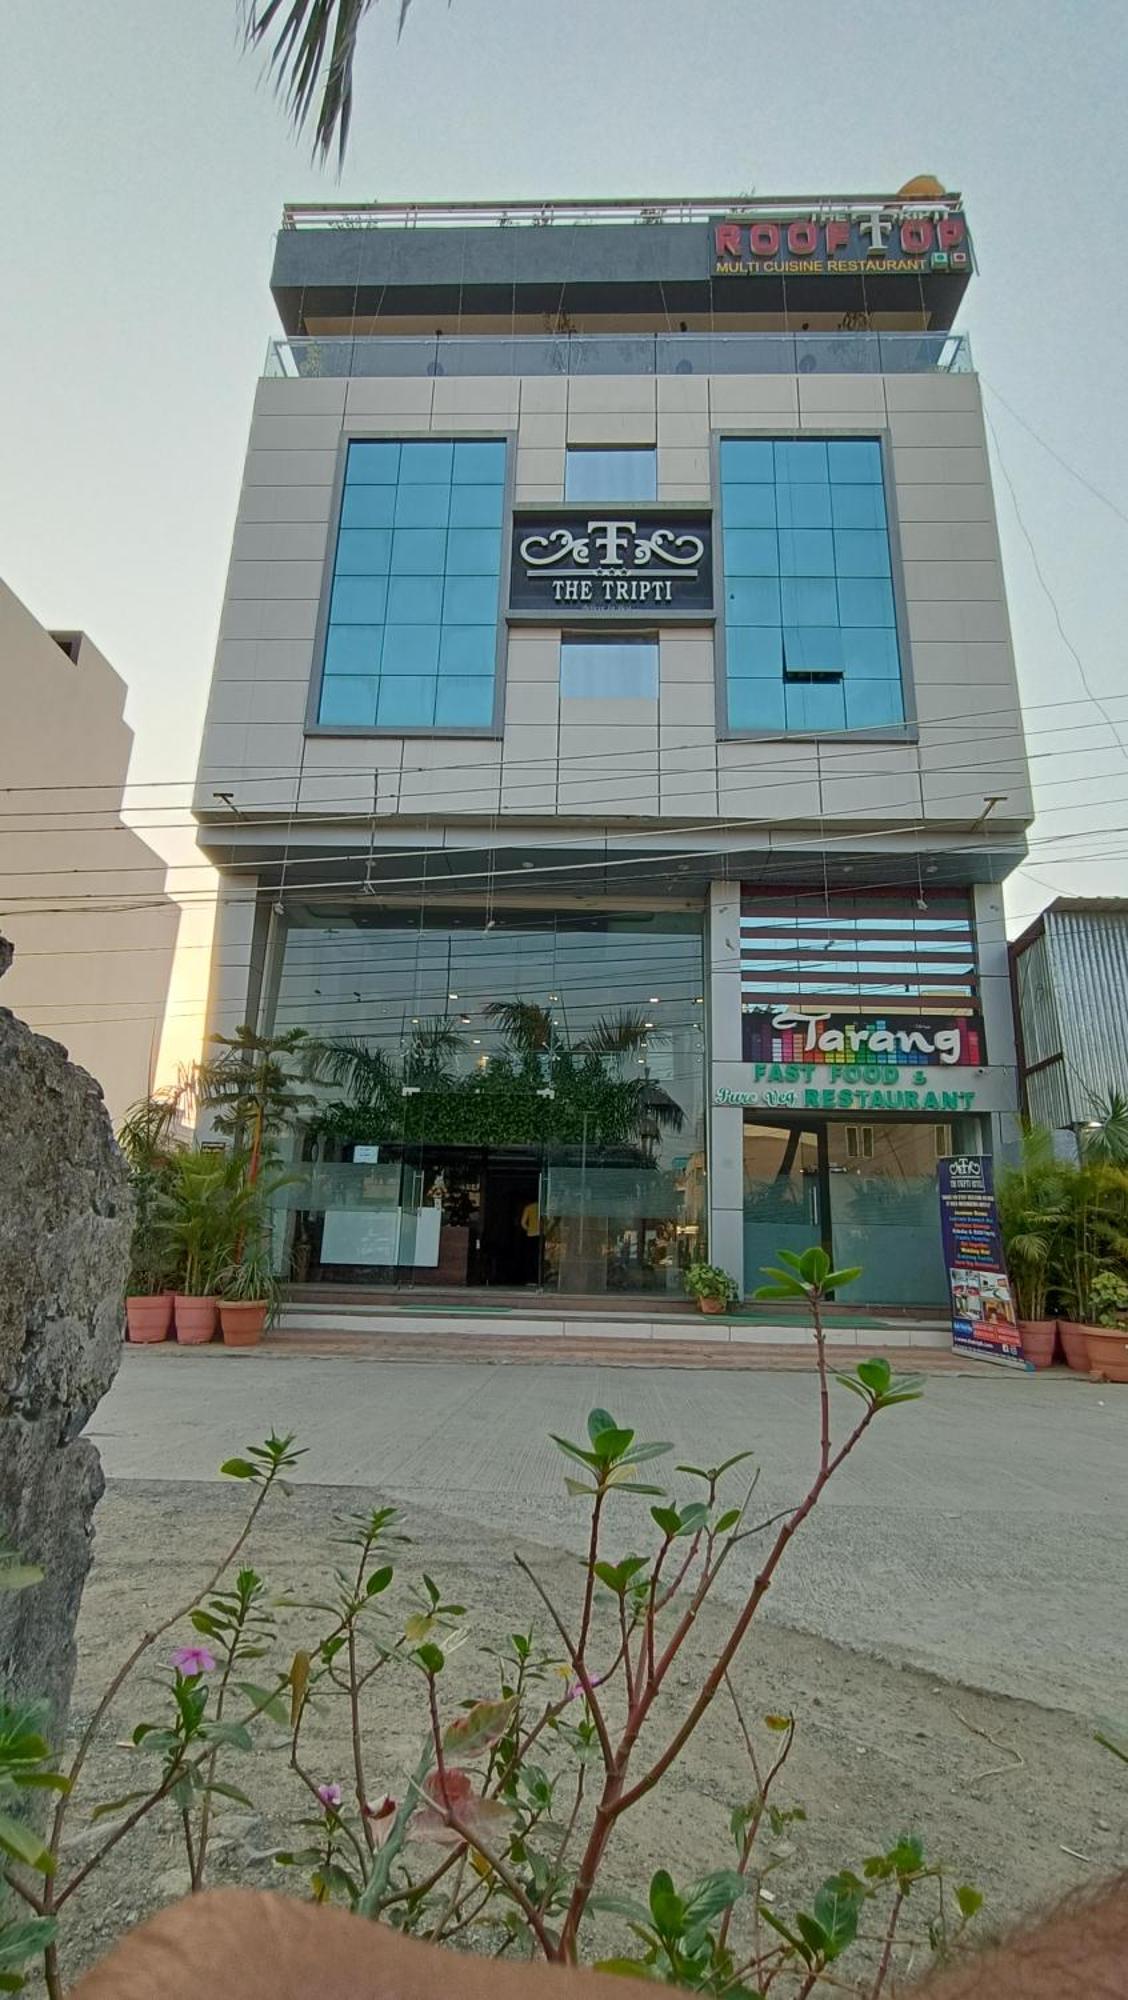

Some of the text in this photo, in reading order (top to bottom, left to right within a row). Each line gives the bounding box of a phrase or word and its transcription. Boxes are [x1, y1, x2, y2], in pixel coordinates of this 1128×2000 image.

[716, 259, 927, 274] MULTI CUISINE RESTAURANT
[552, 580, 673, 601] THE TRIPTI
[771, 1012, 961, 1065] Tarang
[753, 1065, 928, 1086] FAST FOOD &
[715, 1087, 977, 1111] Pure Veg RESTAURANT
